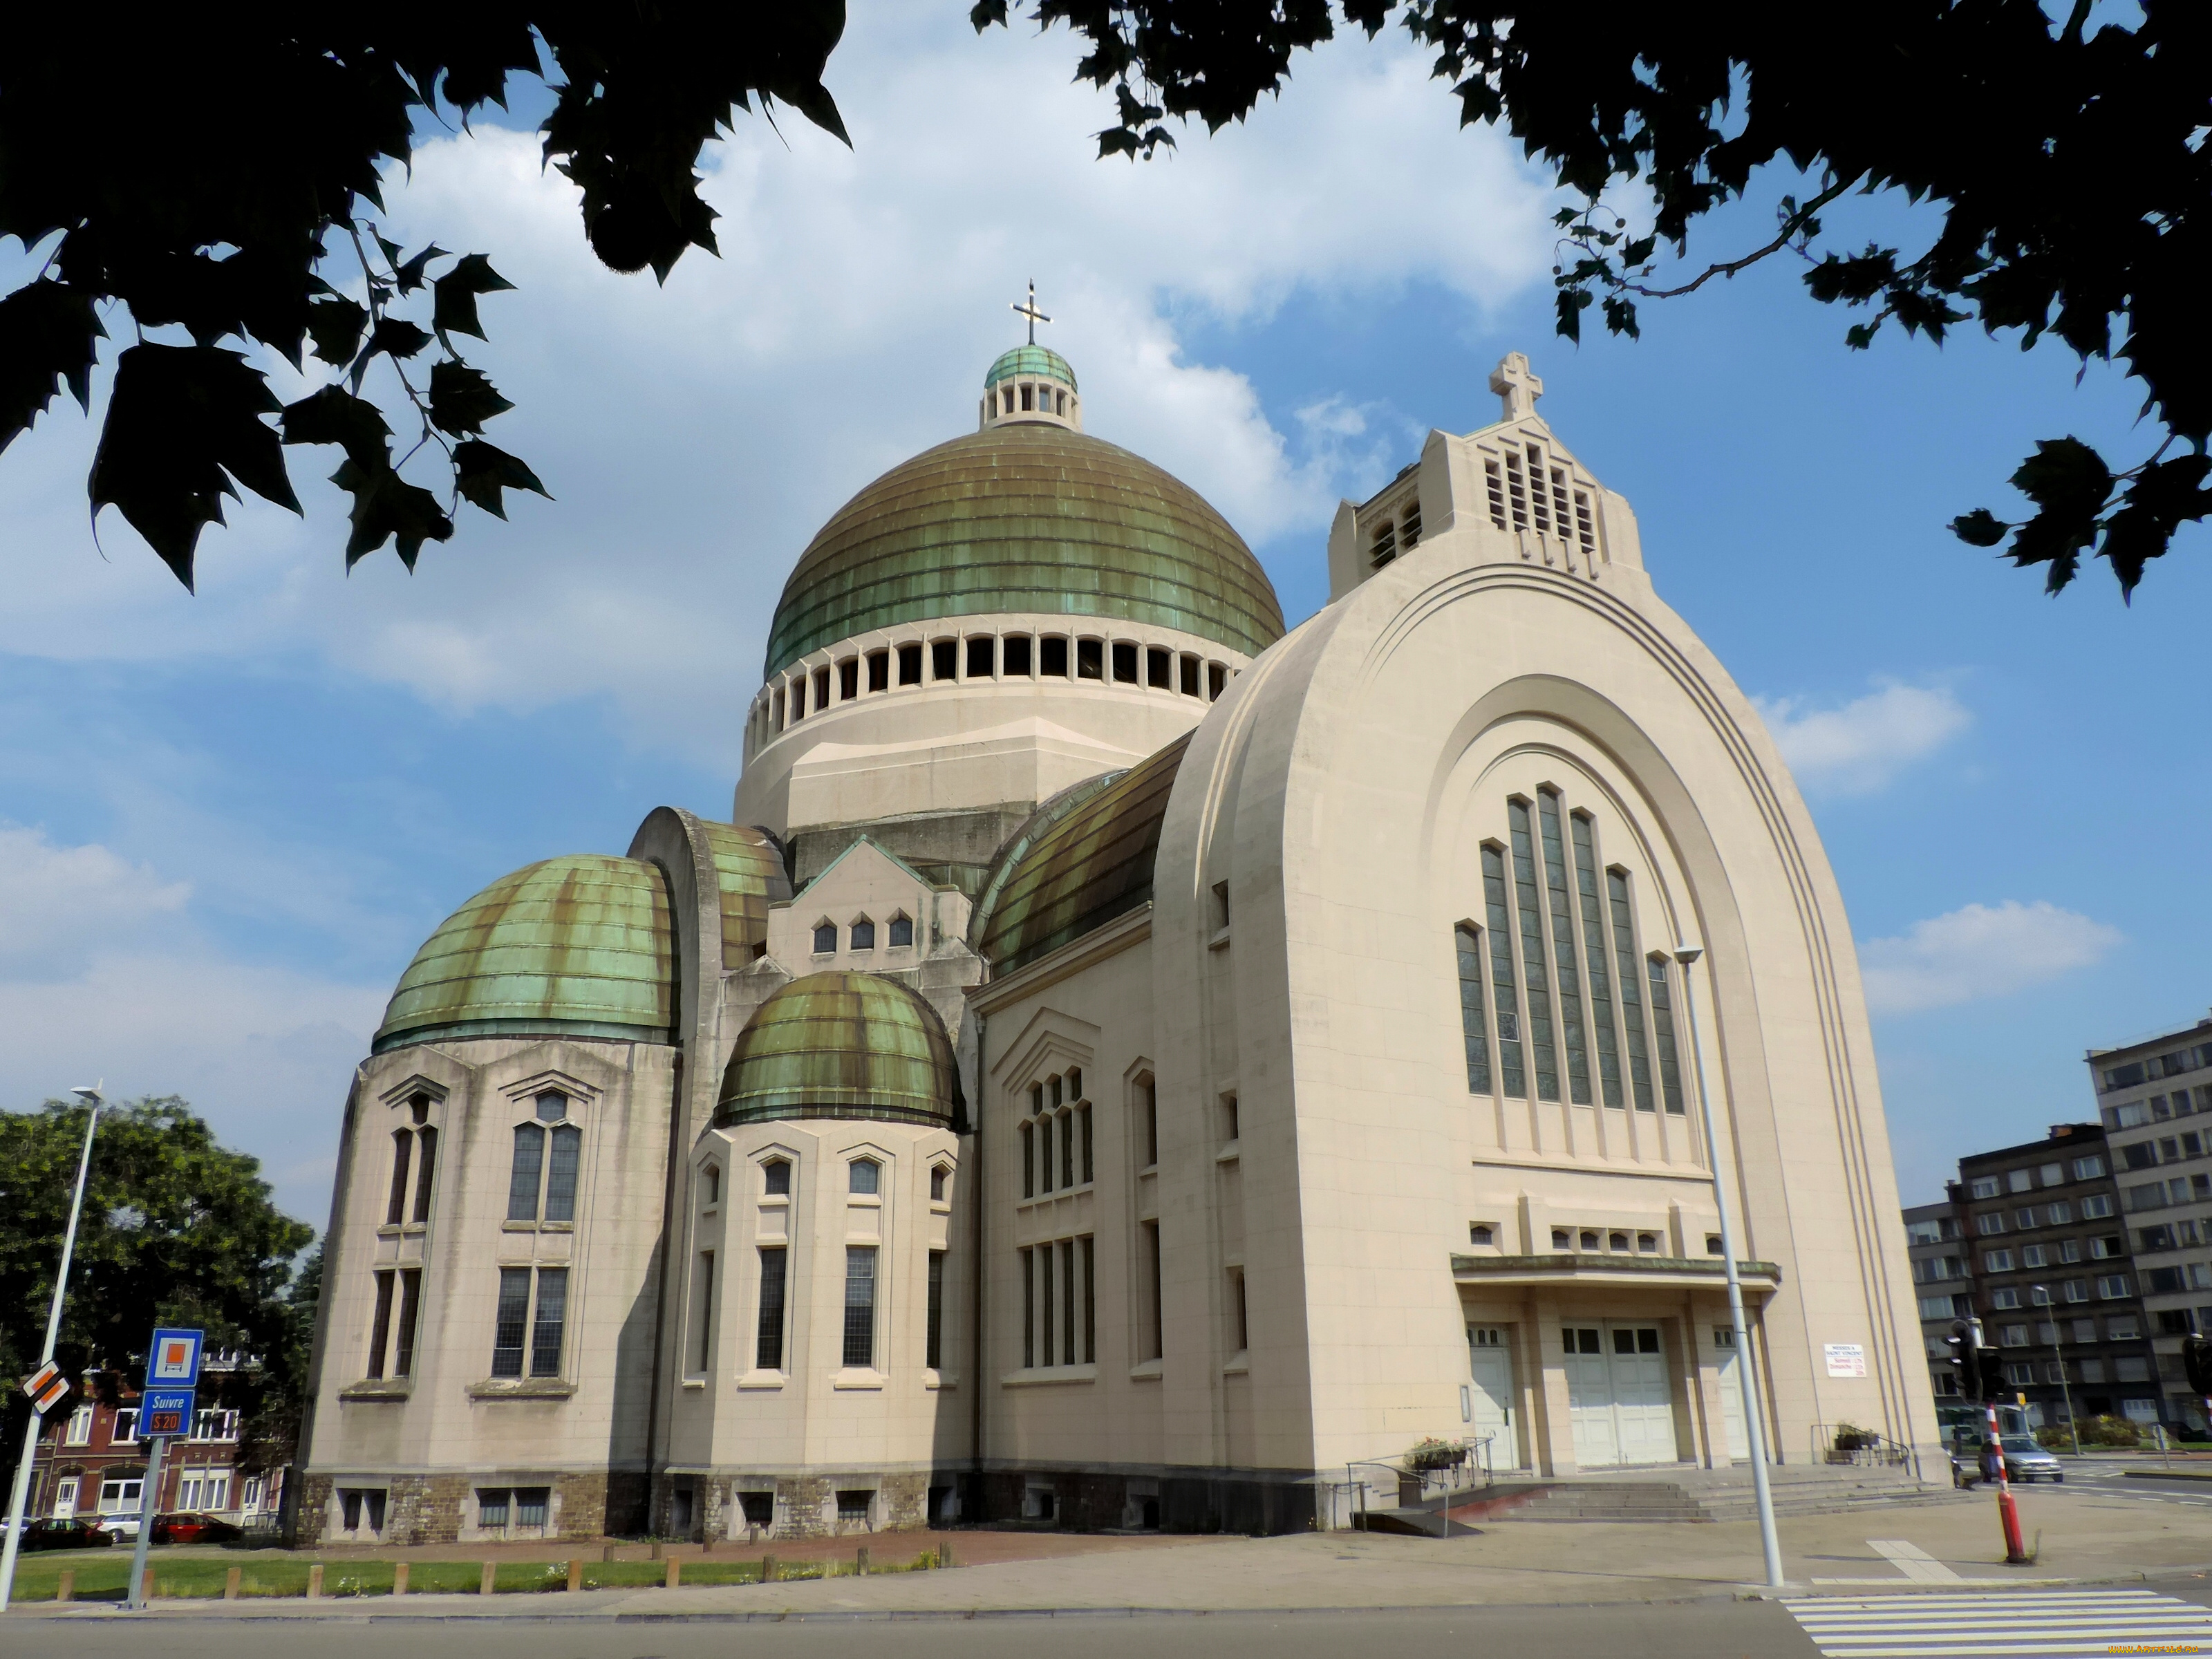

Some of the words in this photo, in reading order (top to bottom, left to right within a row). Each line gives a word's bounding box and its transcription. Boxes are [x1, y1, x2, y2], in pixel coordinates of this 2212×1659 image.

[153, 1396, 185, 1408] Suivre
[153, 1416, 161, 1429] S
[162, 1415, 178, 1429] 20
